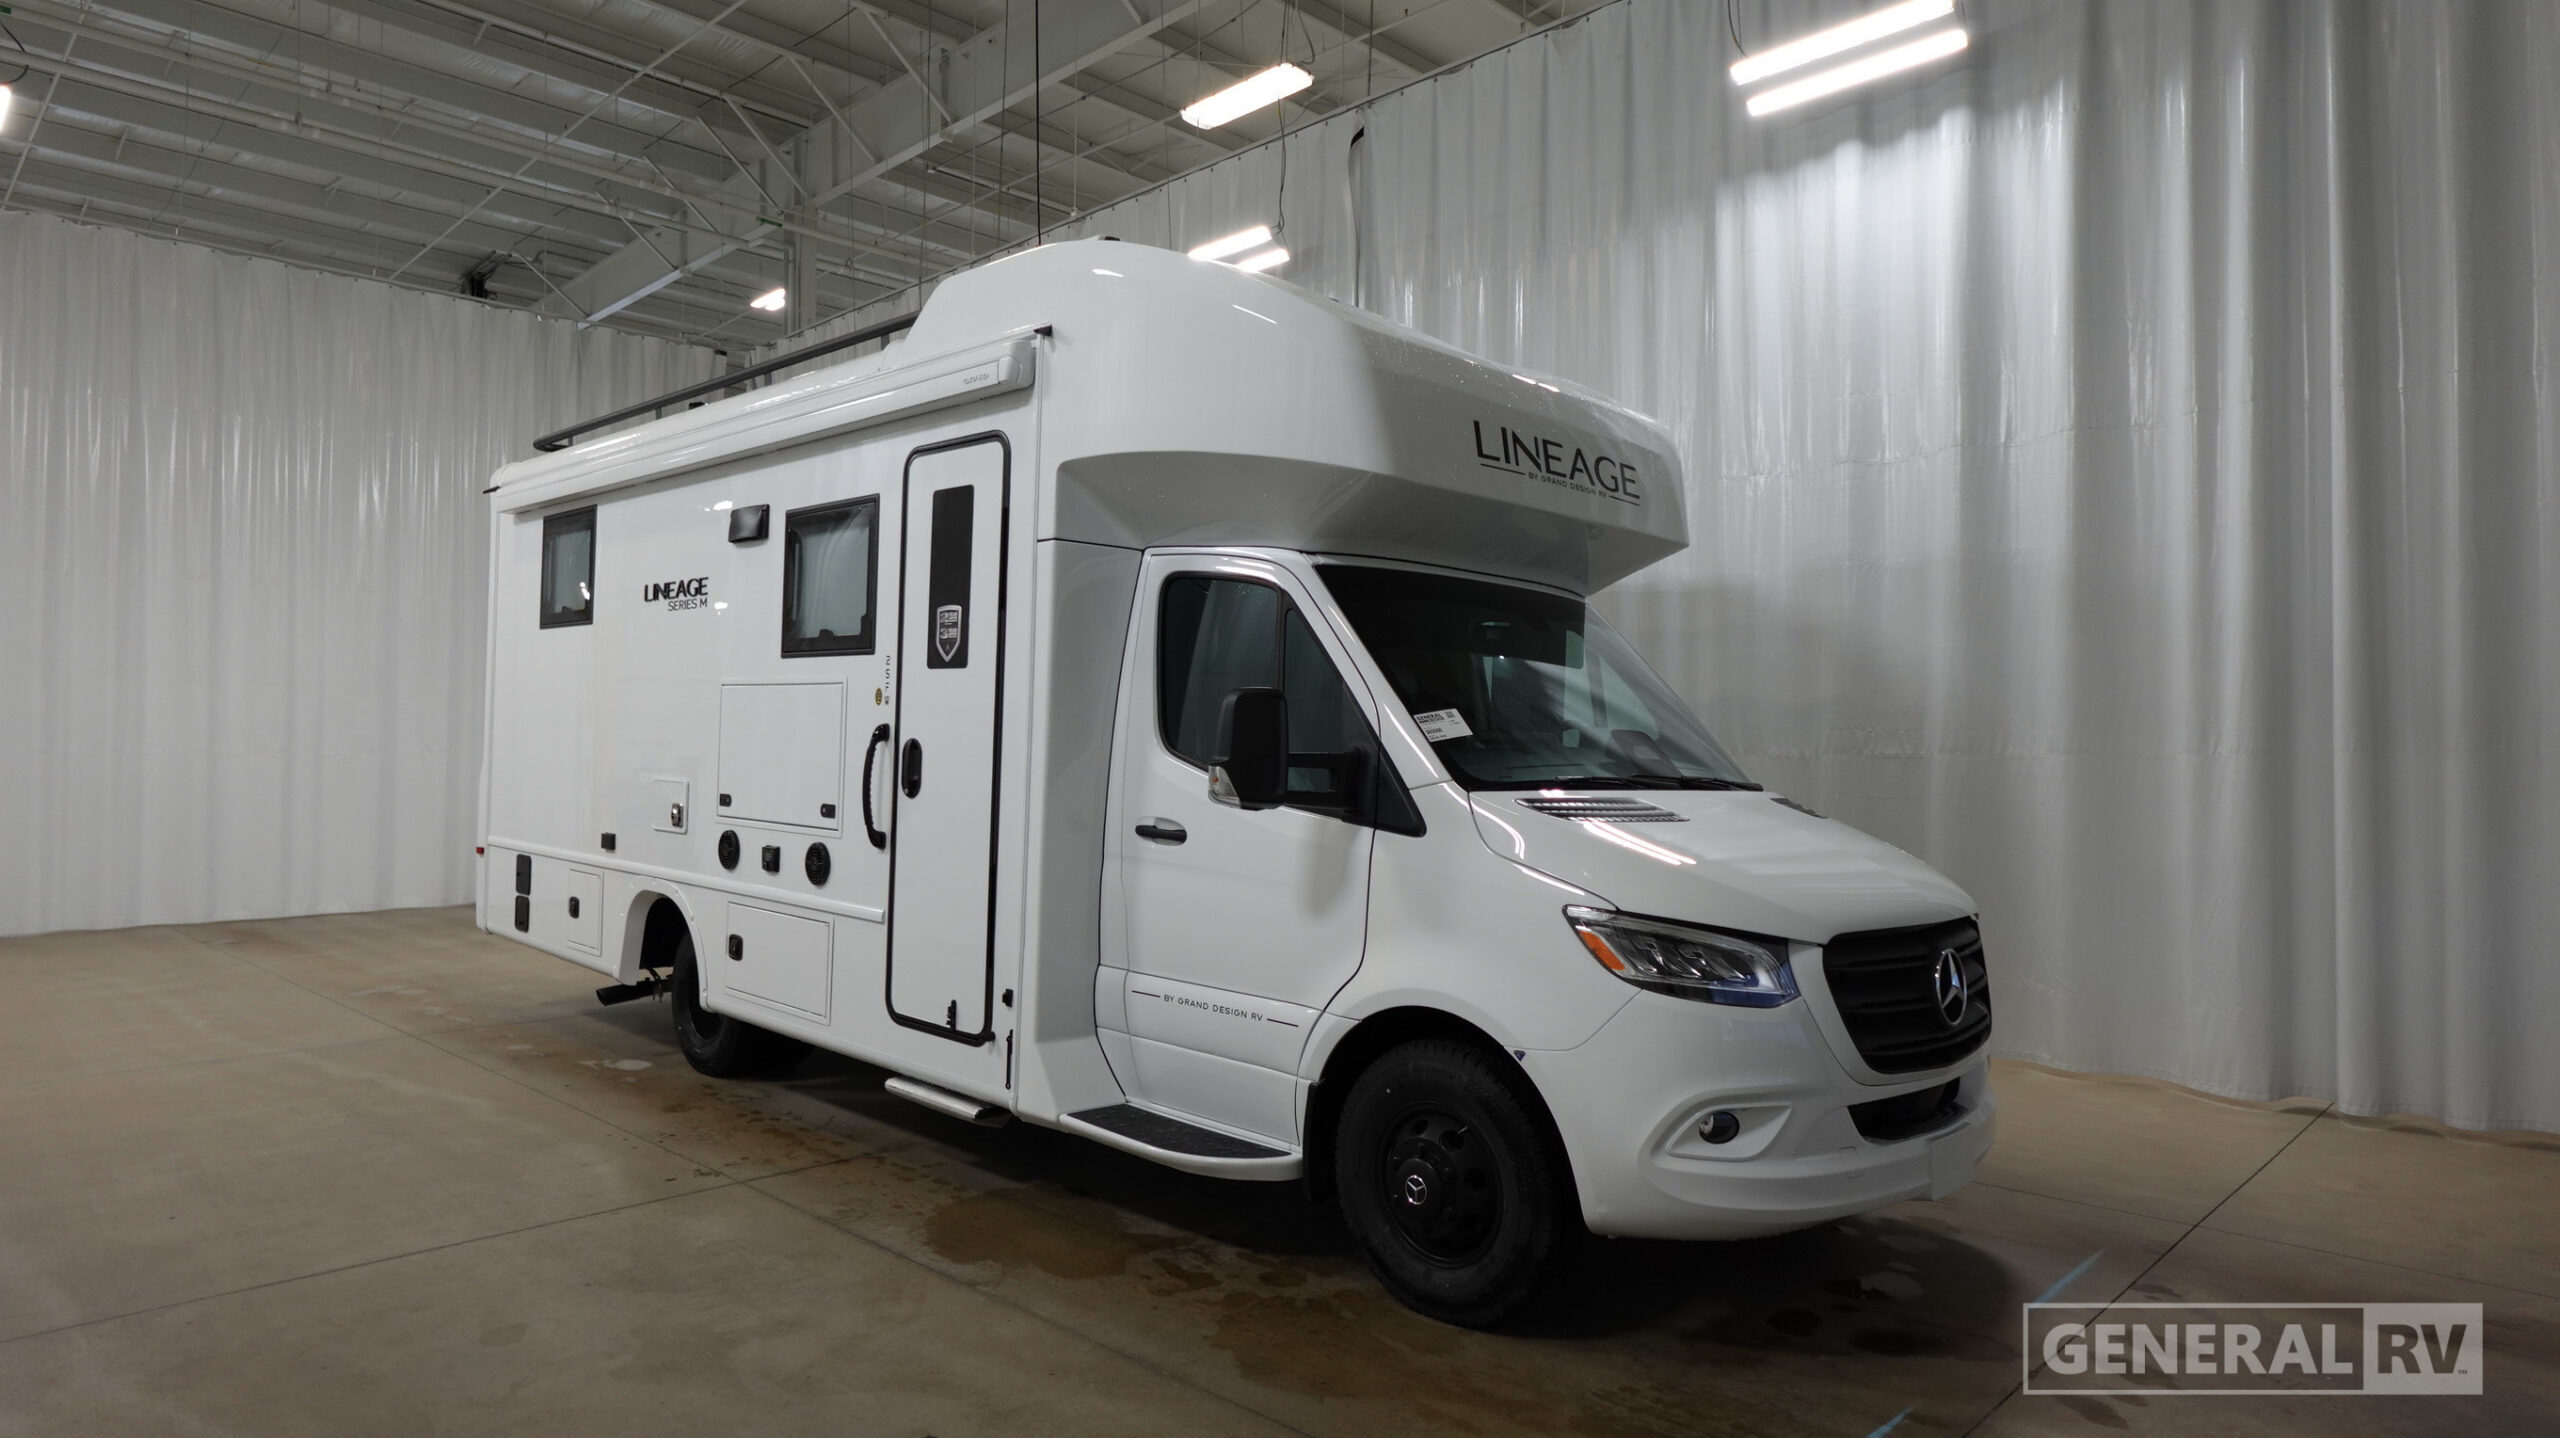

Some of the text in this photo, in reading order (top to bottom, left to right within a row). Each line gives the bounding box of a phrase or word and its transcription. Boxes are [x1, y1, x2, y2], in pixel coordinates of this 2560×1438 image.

[1473, 420, 1641, 500] LINEAGE
[1528, 471, 1608, 499] BY GRAND DESIGN RV
[644, 576, 709, 603] LINEAGE
[667, 597, 708, 612] SERIES M
[1163, 994, 1264, 1022] BY GRAND DESIGN RV
